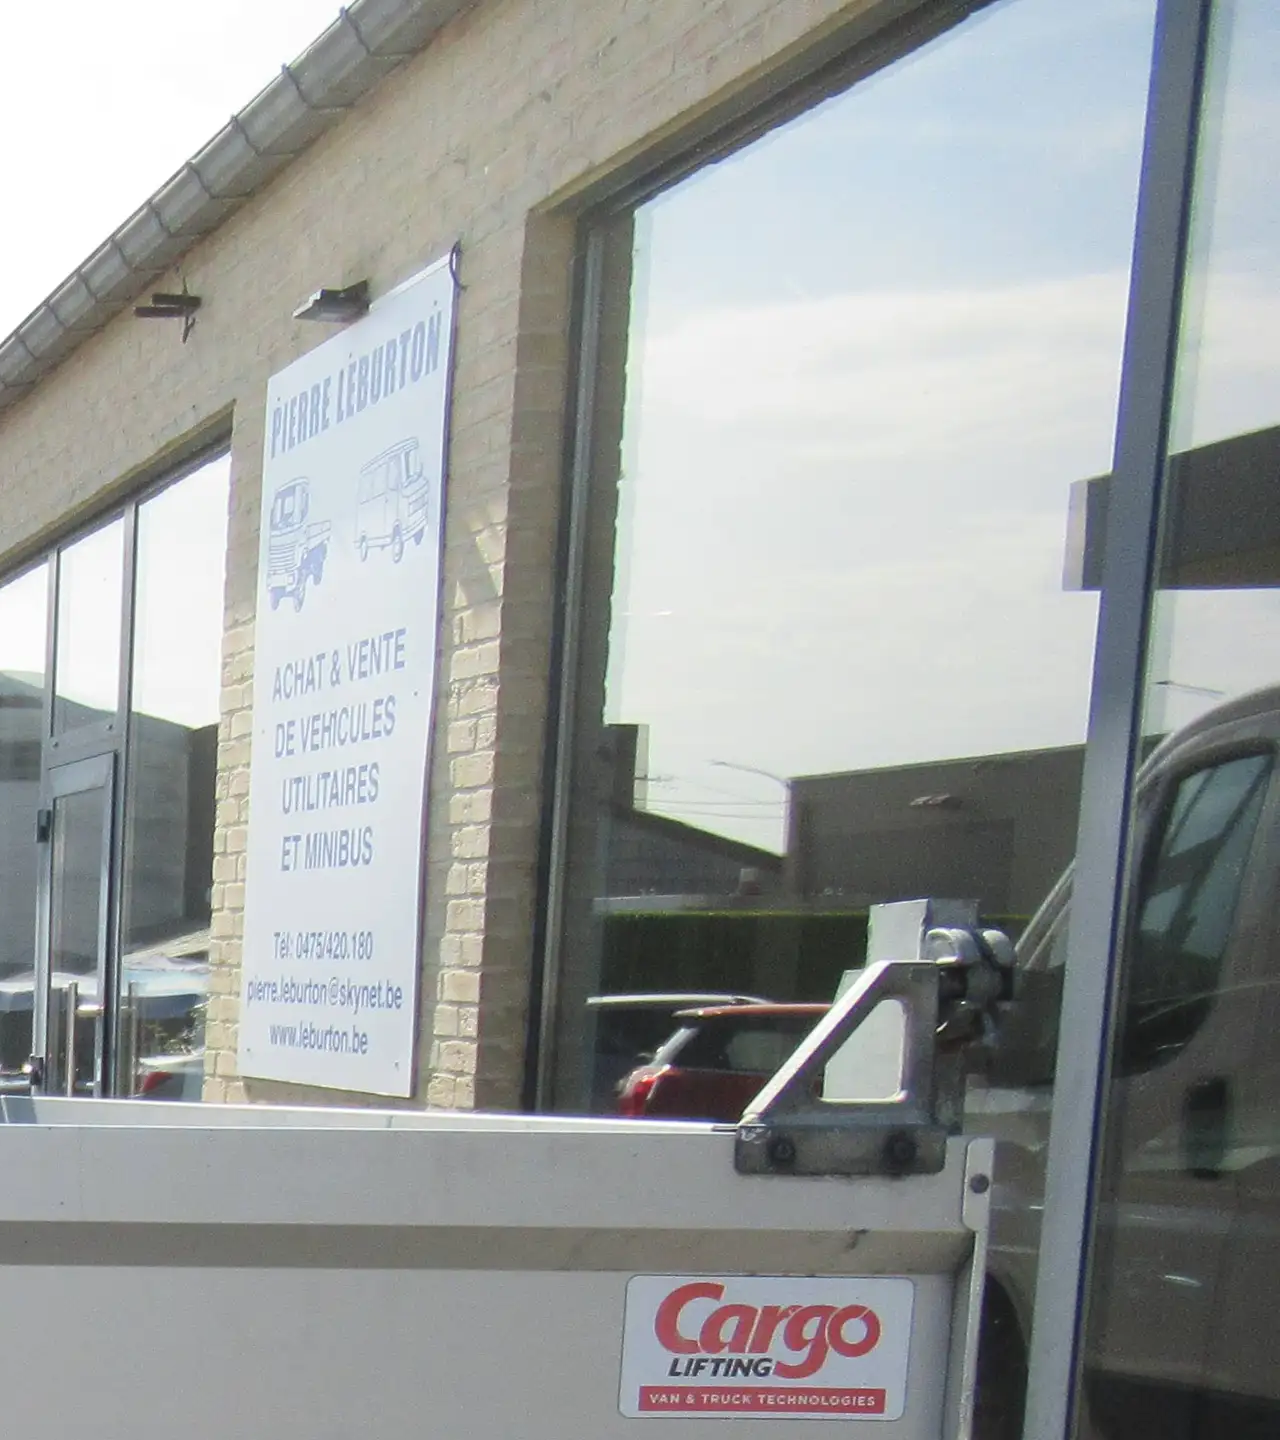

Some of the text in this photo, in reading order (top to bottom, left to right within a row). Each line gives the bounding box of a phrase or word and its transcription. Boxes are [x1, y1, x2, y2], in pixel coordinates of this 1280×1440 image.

[271, 310, 442, 460] PIERRE LEBURTON
[272, 627, 407, 702] ACHAT & VENTE
[274, 694, 396, 759] DE VEHICULES
[282, 761, 380, 815] UTILITAIRES
[281, 825, 374, 872] ET MINIBUS
[296, 930, 374, 961] 0475/420.180
[247, 976, 403, 1015] pierre.leburton@skynet.be
[269, 1020, 369, 1055] www.leburton.be
[654, 1281, 881, 1379] Cargo
[667, 1357, 773, 1378] LIFTING
[649, 1393, 876, 1406] VAN & TRUCK TECHNOLOGIES
